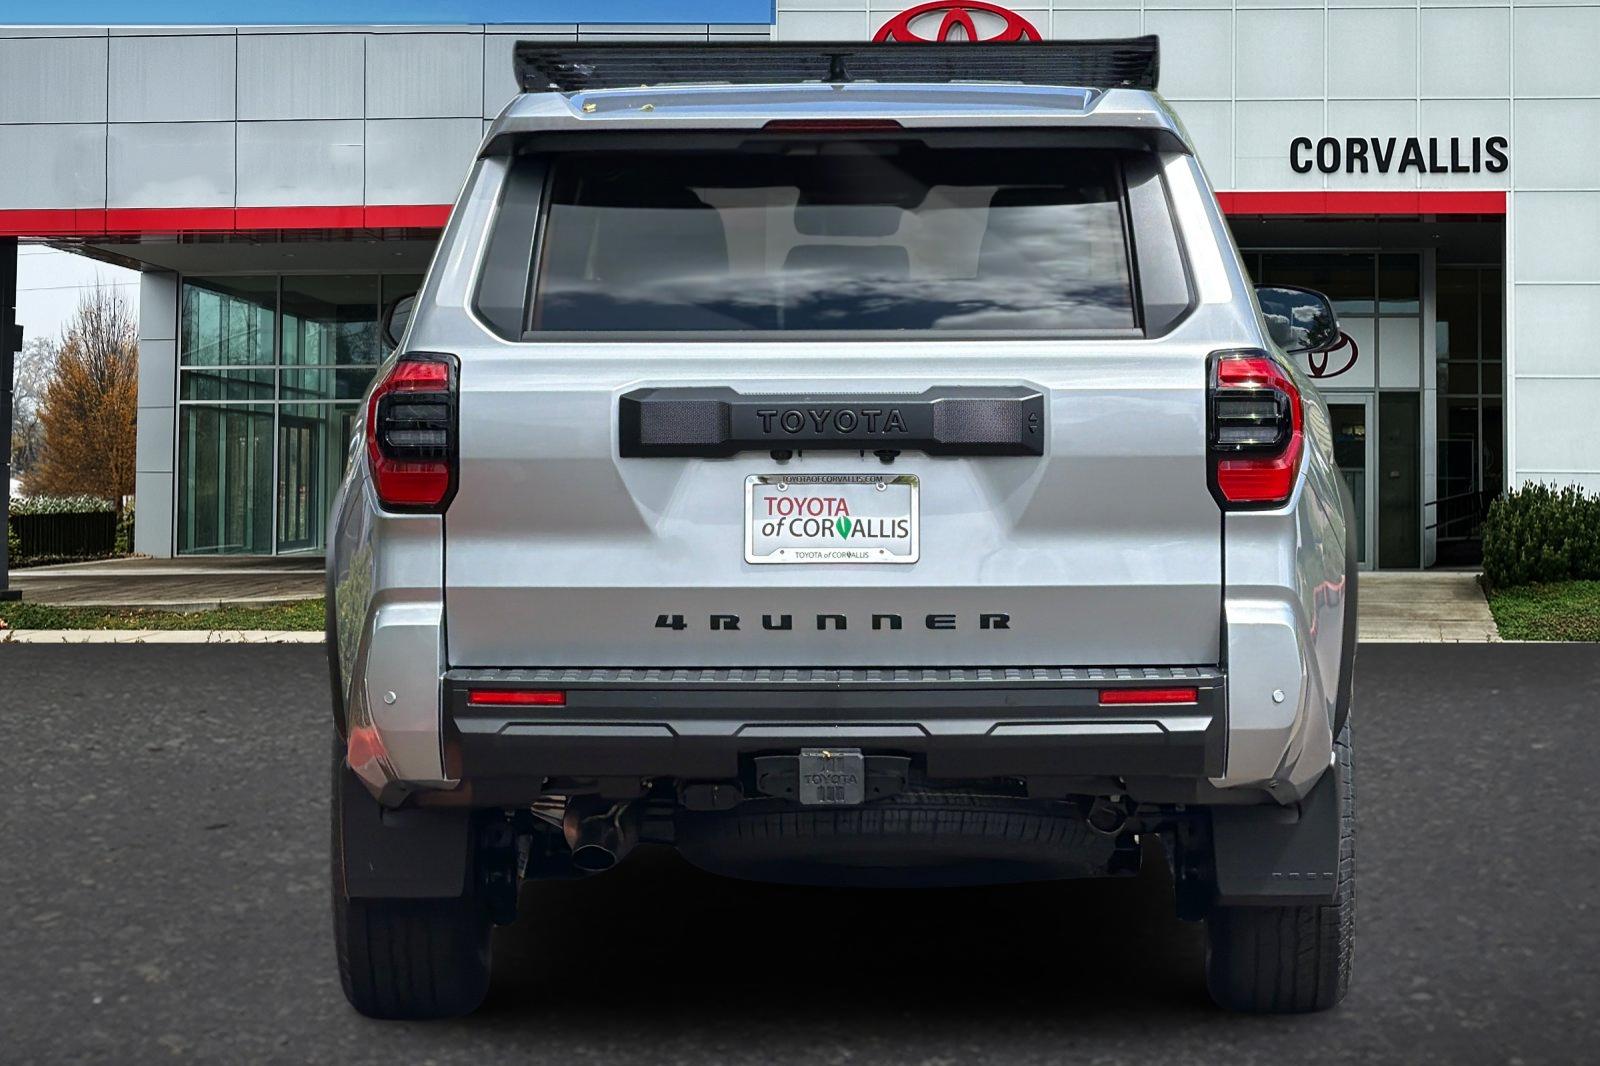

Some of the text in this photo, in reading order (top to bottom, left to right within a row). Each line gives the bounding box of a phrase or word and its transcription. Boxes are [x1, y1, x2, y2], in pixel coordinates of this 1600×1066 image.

[1290, 136, 1509, 173] CORVALLIS
[757, 409, 908, 433] TOYOTA
[782, 475, 883, 483] TOYOTAOFCORVALLIS.COM
[764, 497, 849, 516] TOYOTA
[762, 517, 786, 537] of
[795, 551, 823, 559] TOYOTA
[823, 551, 831, 559] of
[655, 614, 1011, 630] 4RUNNER
[804, 774, 858, 785] TOYOTA
